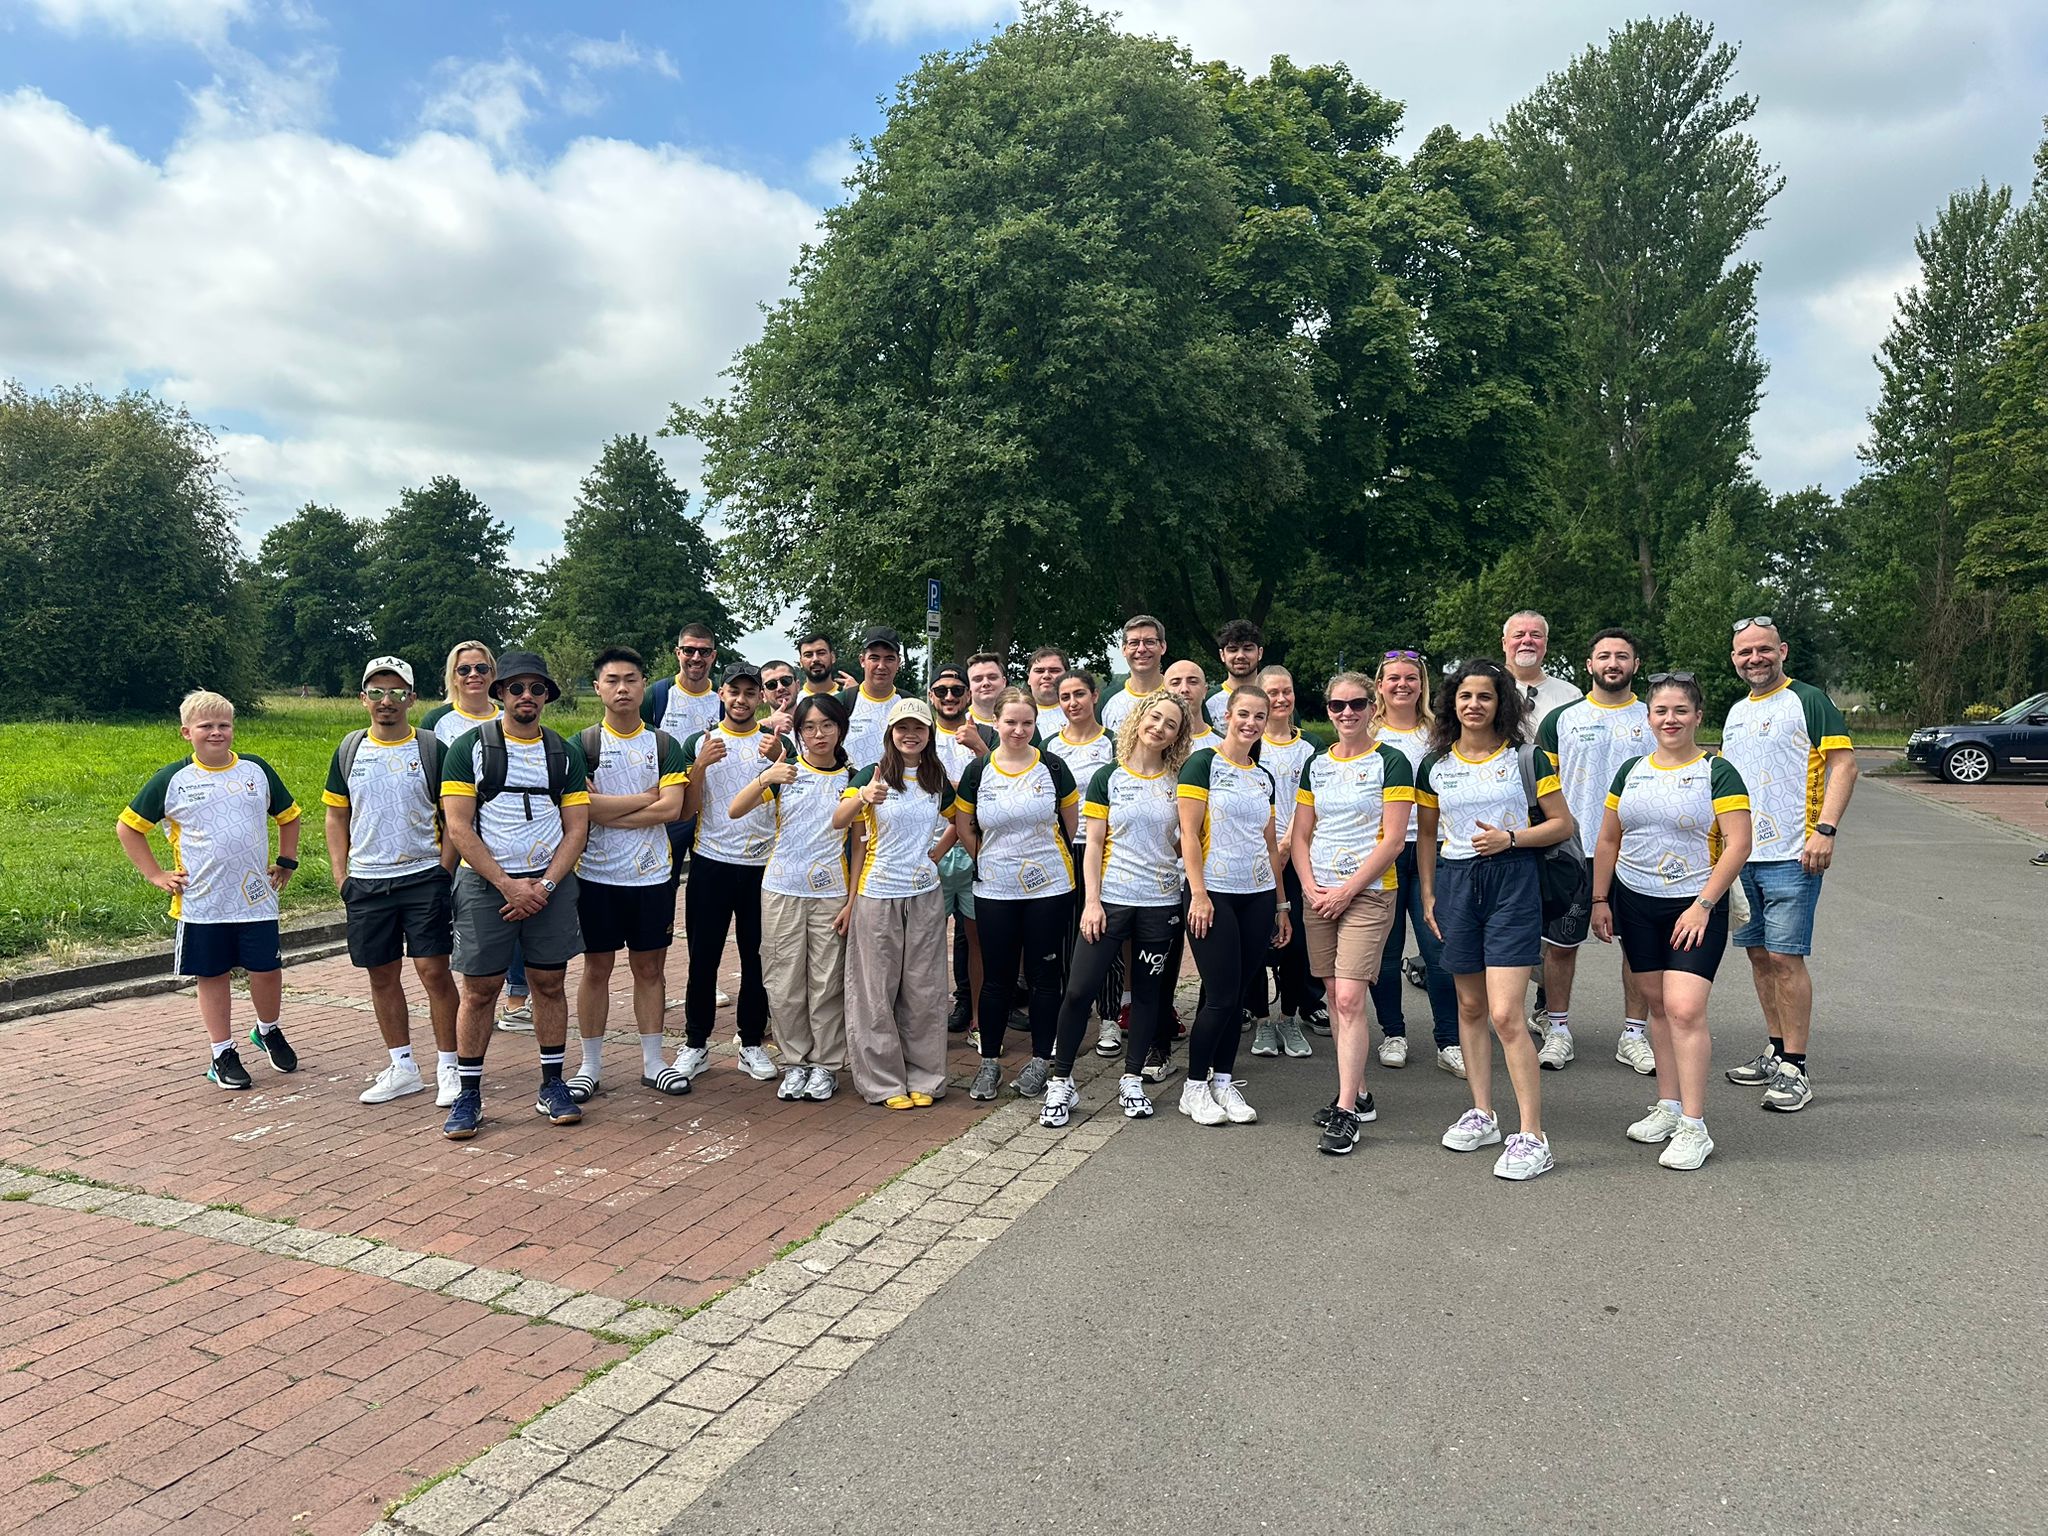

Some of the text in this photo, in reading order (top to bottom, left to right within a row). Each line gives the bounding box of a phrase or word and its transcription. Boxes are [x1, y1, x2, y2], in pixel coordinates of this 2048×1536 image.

[931, 583, 938, 607] P
[376, 657, 405, 669] LAX
[1027, 877, 1047, 890] RACE
